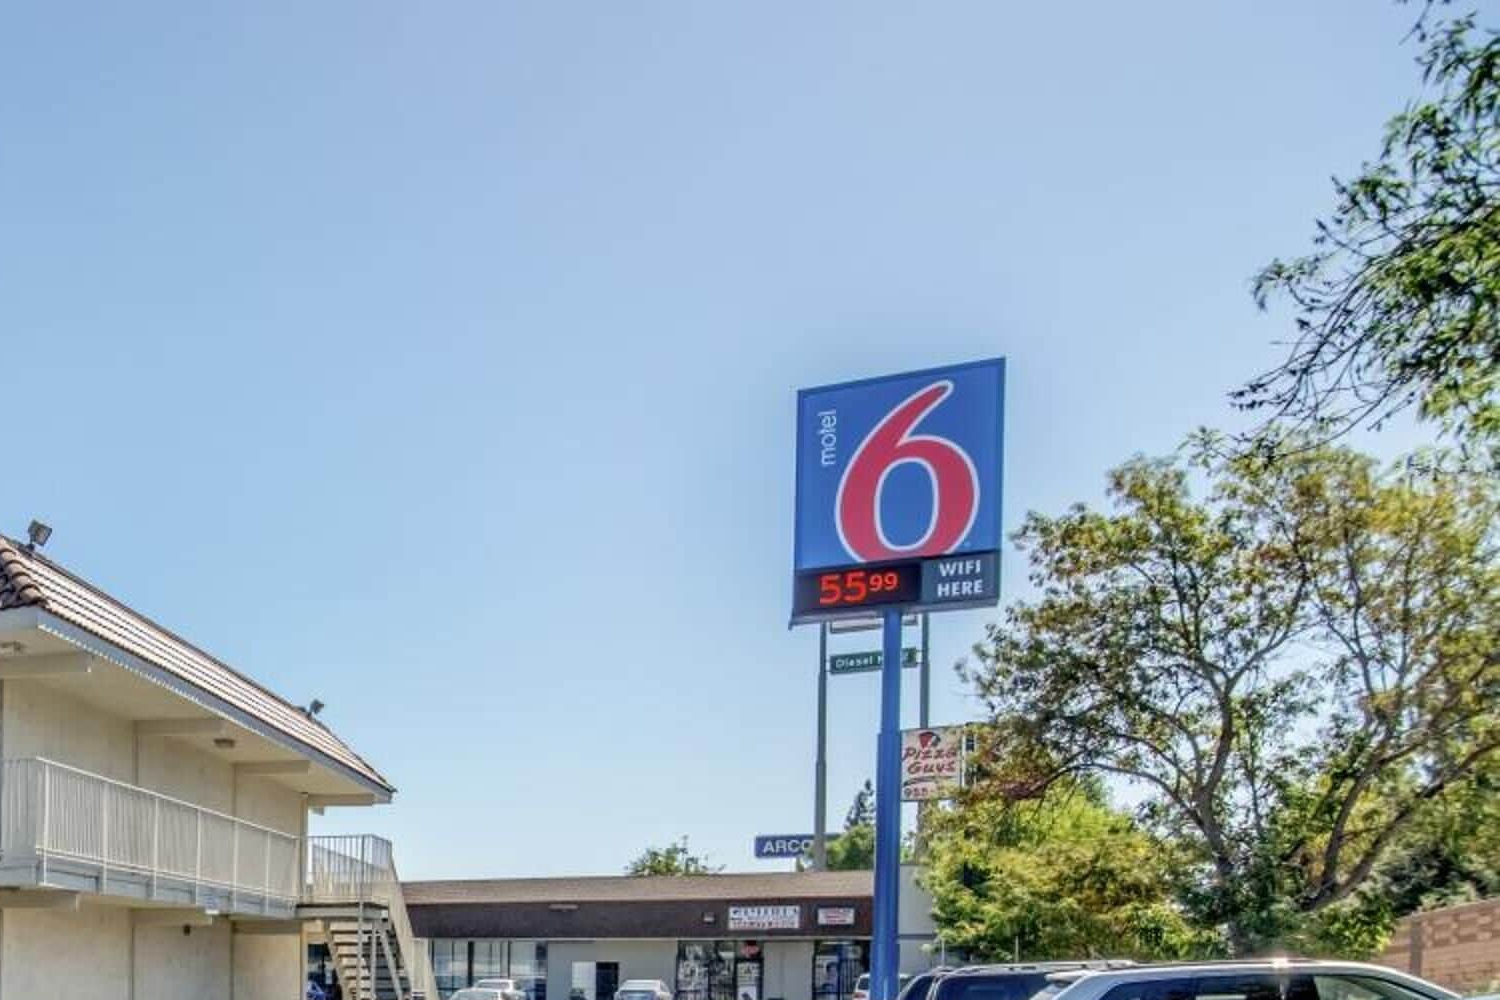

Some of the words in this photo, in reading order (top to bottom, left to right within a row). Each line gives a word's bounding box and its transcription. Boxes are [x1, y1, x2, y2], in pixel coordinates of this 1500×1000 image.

[817, 409, 837, 467] motel
[835, 379, 980, 563] 6
[939, 559, 981, 577] WIFI
[937, 579, 983, 598] HERE
[835, 655, 873, 669] Diesel
